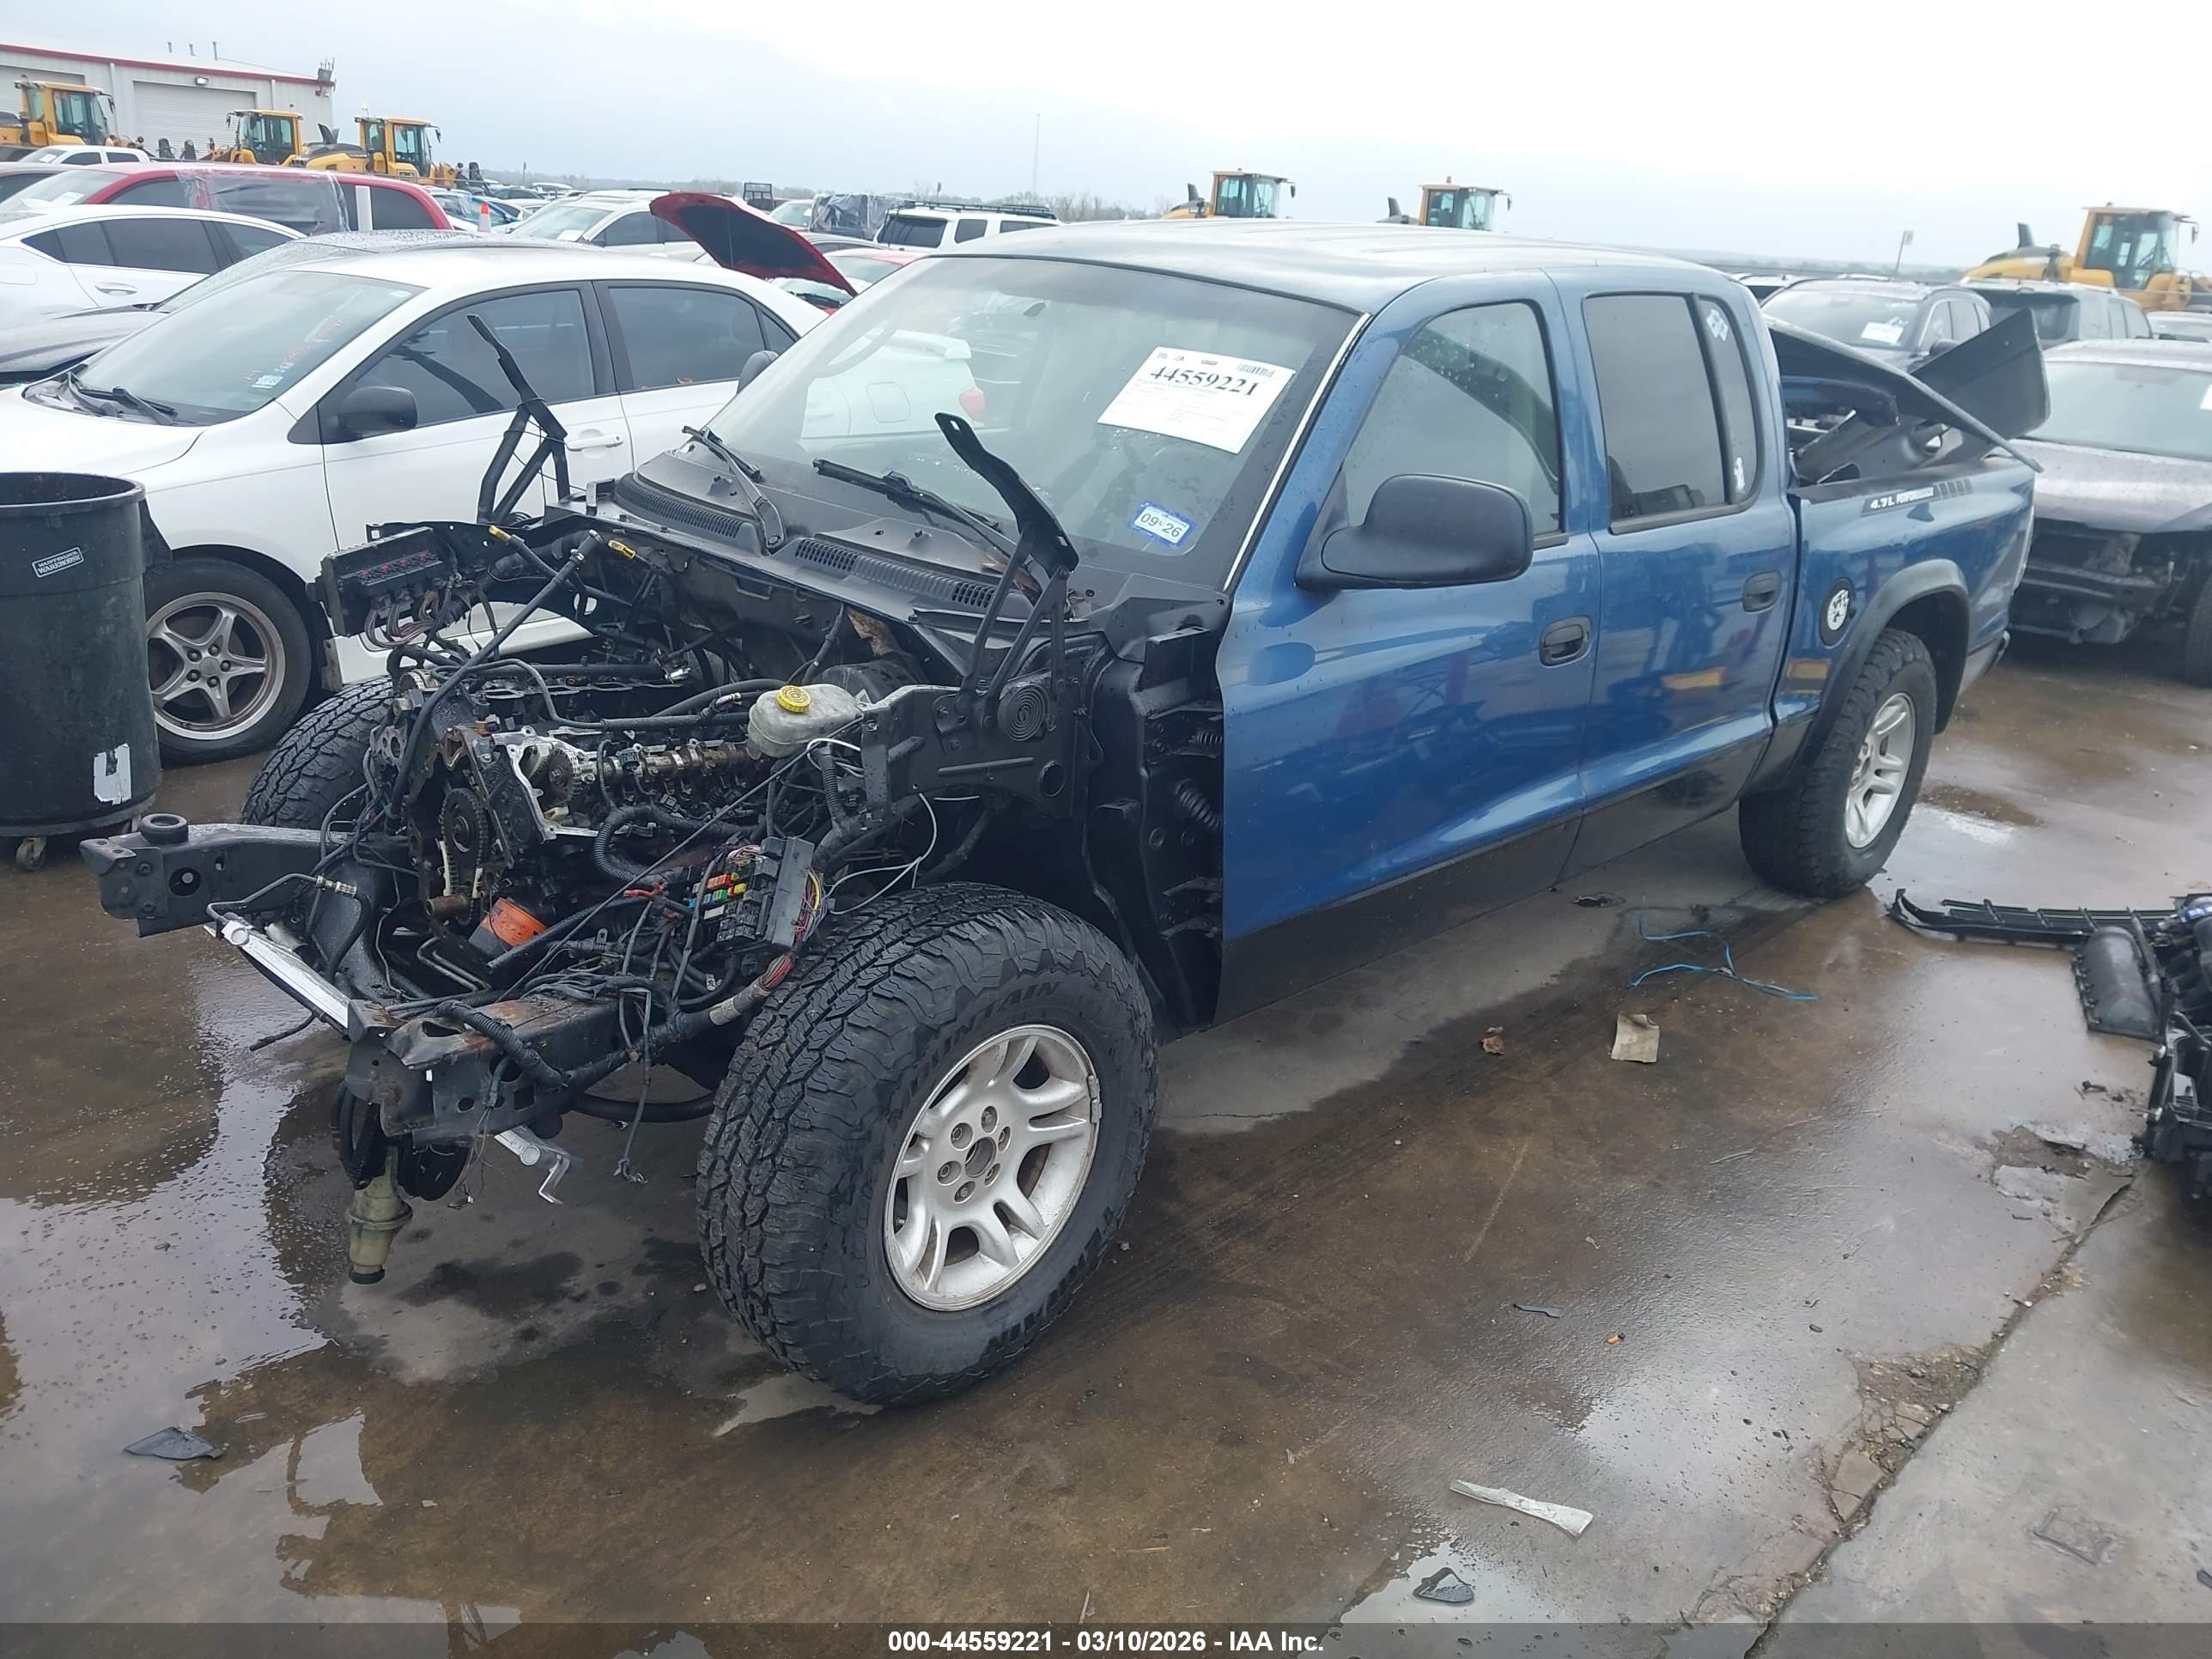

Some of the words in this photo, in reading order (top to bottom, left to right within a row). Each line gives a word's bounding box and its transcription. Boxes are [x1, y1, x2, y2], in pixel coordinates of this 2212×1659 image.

[1151, 366, 1259, 396] 44559221
[1140, 514, 1159, 526] 09
[1162, 523, 1182, 538] 26
